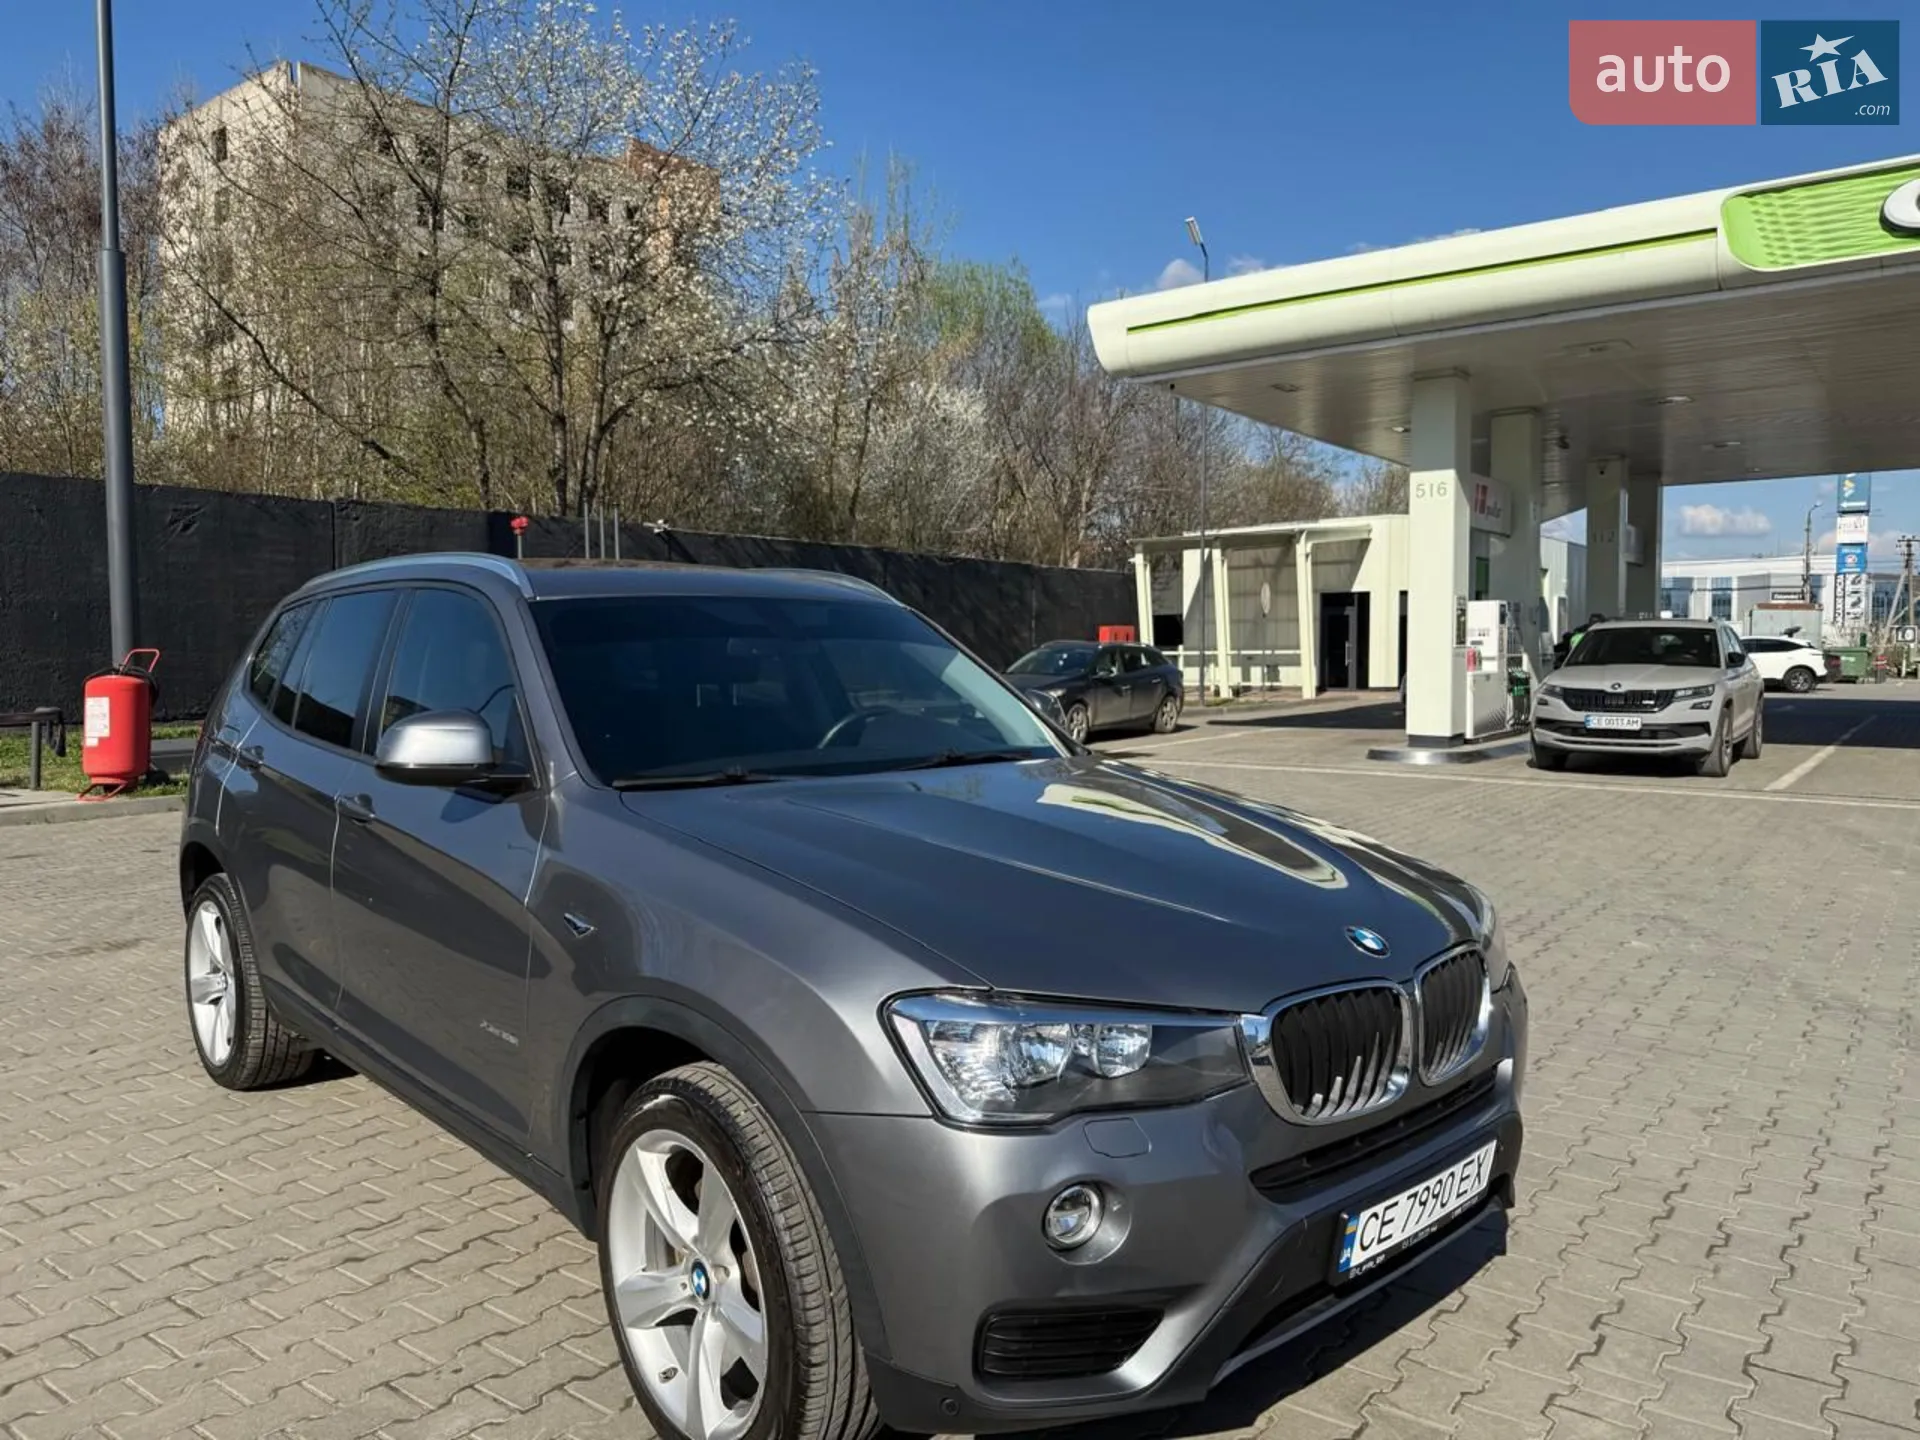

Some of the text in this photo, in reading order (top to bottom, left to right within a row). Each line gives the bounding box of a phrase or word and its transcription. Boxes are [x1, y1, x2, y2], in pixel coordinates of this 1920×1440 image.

[1359, 1201, 1399, 1251] CE
[1401, 1171, 1455, 1234] 7990
[1456, 1149, 1489, 1200] EX
